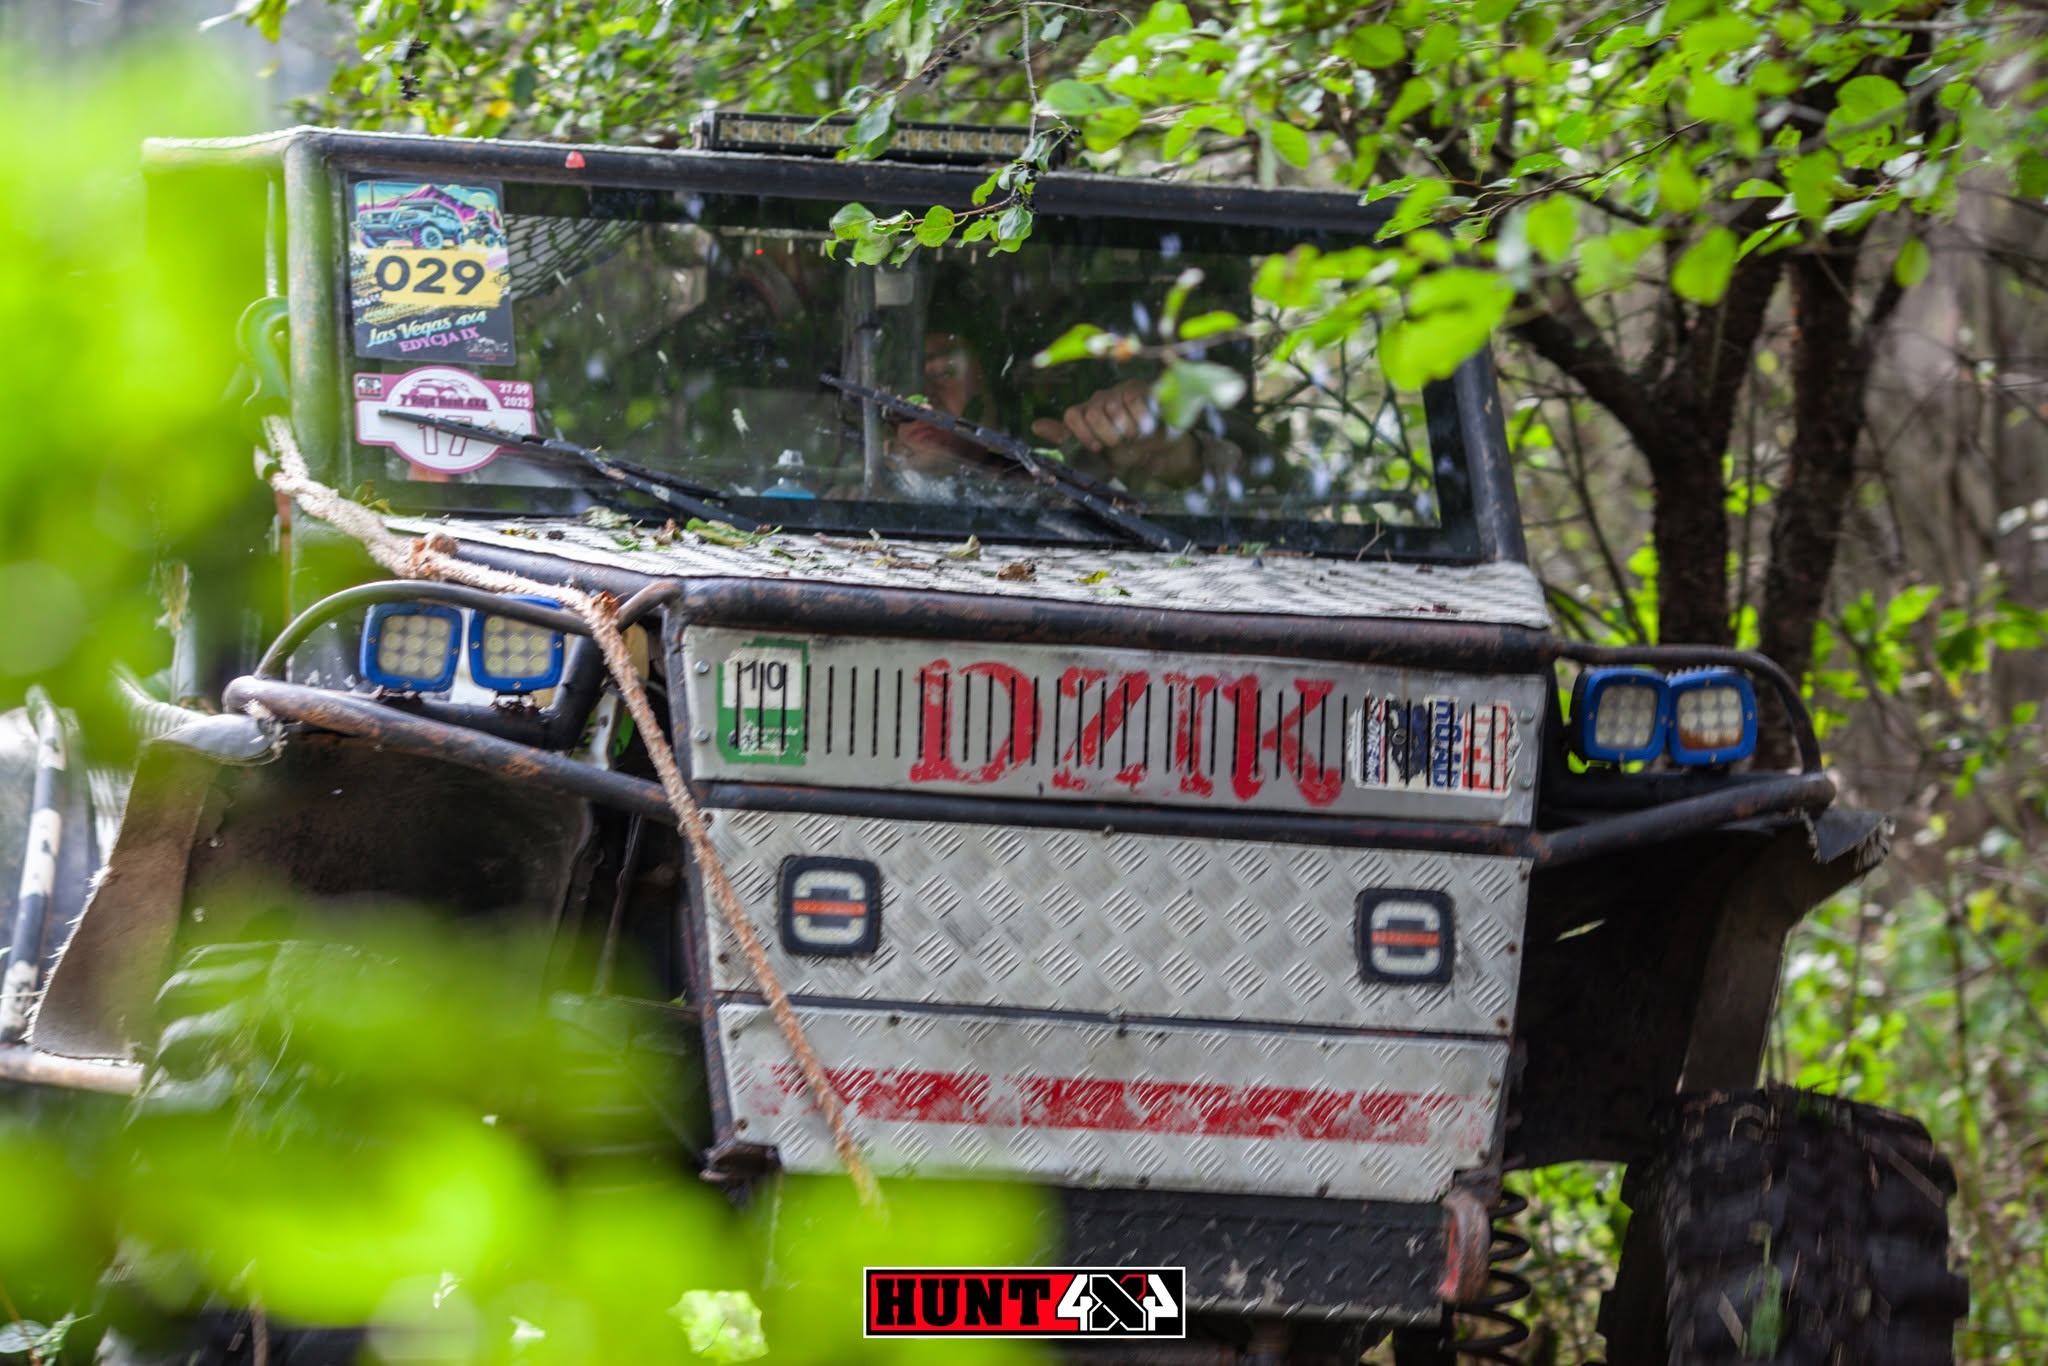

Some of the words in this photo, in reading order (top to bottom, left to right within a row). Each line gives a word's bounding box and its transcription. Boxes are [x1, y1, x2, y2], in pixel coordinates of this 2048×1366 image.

[376, 255, 485, 295] 029
[366, 325, 397, 347] Las
[397, 318, 453, 338] Vegas
[399, 333, 460, 352] EDYCJA
[460, 327, 480, 341] IX
[503, 397, 530, 408] 2025
[418, 413, 473, 456] 17
[740, 660, 786, 690] 10
